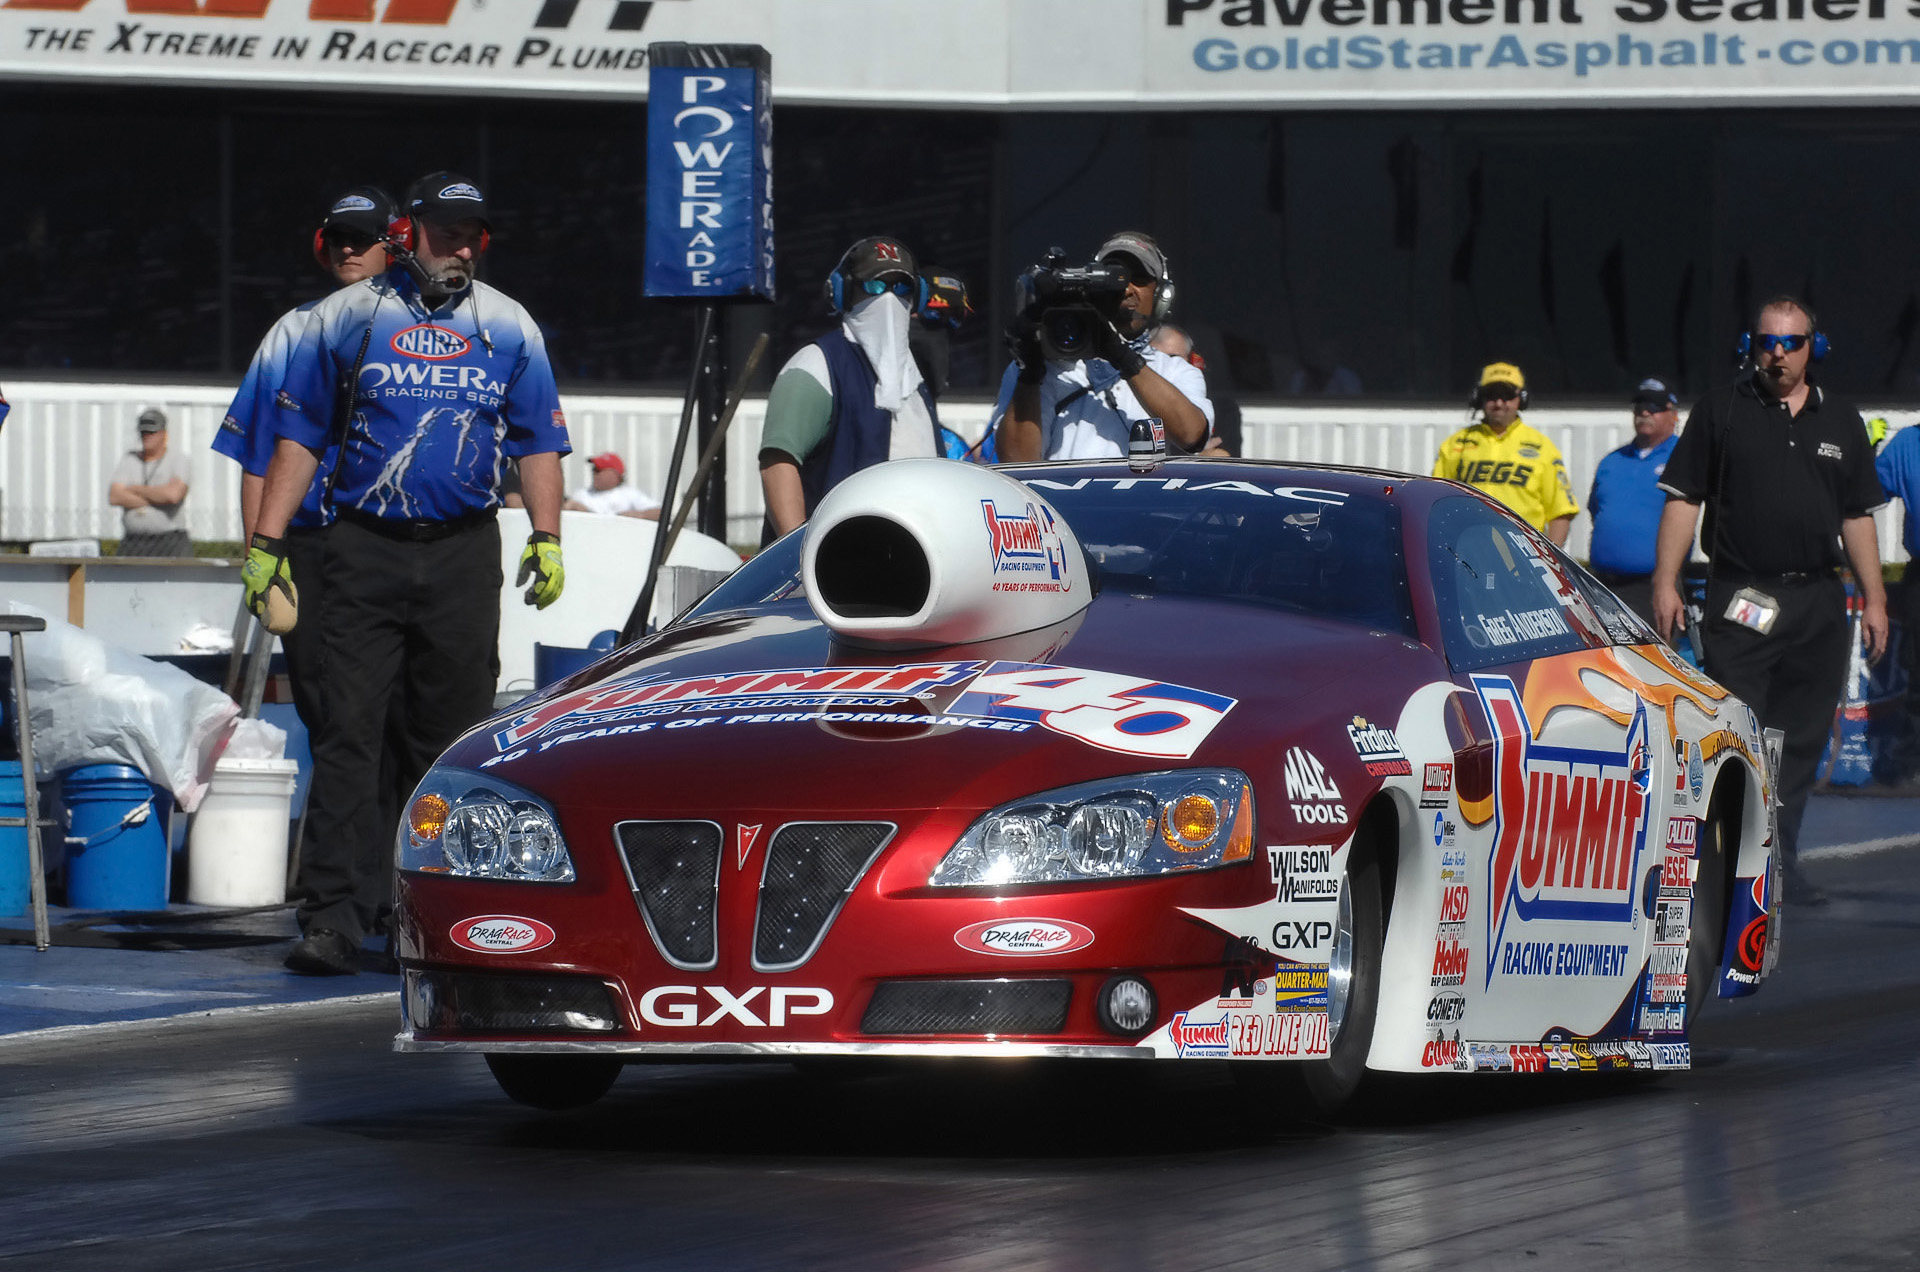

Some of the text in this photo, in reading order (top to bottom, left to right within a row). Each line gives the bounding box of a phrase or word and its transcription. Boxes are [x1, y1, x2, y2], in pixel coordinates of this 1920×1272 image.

[25, 22, 648, 70] THE XTREME IN RACECAR PLUMB
[672, 75, 734, 287] POWERADE
[874, 243, 901, 263] N
[401, 328, 462, 355] NHRA
[359, 363, 507, 396] OWERA
[386, 388, 457, 400] RACING
[466, 391, 505, 408] SER
[1021, 478, 1350, 506] NTIAC
[1001, 562, 1046, 571] RACING EQUIPMENT
[992, 583, 1060, 592] 40 YEARS OF PERFORMANCE
[1477, 613, 1518, 646] GREG
[1505, 607, 1570, 642] ANDERSON
[494, 660, 988, 752] SUMMIT
[540, 695, 909, 737] RACING EQUIPMENT
[479, 710, 1035, 770] 40 YEARS OF PERFORMANCE!
[1346, 723, 1405, 762] Findlay
[1284, 747, 1342, 800] MAC
[1365, 760, 1412, 777] CHEVROLET
[1291, 804, 1349, 824] TOOLS
[1470, 673, 1653, 994] SUMMIT
[1666, 820, 1695, 845] CALICO
[1270, 851, 1330, 878] WILSON
[1660, 856, 1691, 887] JESEL
[1278, 876, 1338, 903] MANIFOLDS
[1439, 886, 1469, 922] MSD
[1668, 906, 1684, 920] SUPER
[1272, 922, 1332, 949] GXP
[1665, 925, 1686, 939] DAMPER
[1432, 941, 1469, 986] Holley
[1502, 942, 1628, 977] RACING EQUIPMENT
[1275, 971, 1329, 989] QUARTER-MAX
[1431, 975, 1461, 987] HP CARBS
[1653, 974, 1688, 987] PERFORMANCE
[1726, 968, 1754, 984] Power
[639, 985, 834, 1028] GXP
[1427, 998, 1466, 1021] COMETIC
[1640, 1006, 1684, 1036] MagnaFuel
[1231, 1013, 1328, 1057] RED LINE OIL
[1422, 1039, 1458, 1067] COMP
[1453, 1061, 1469, 1071] CAMS
